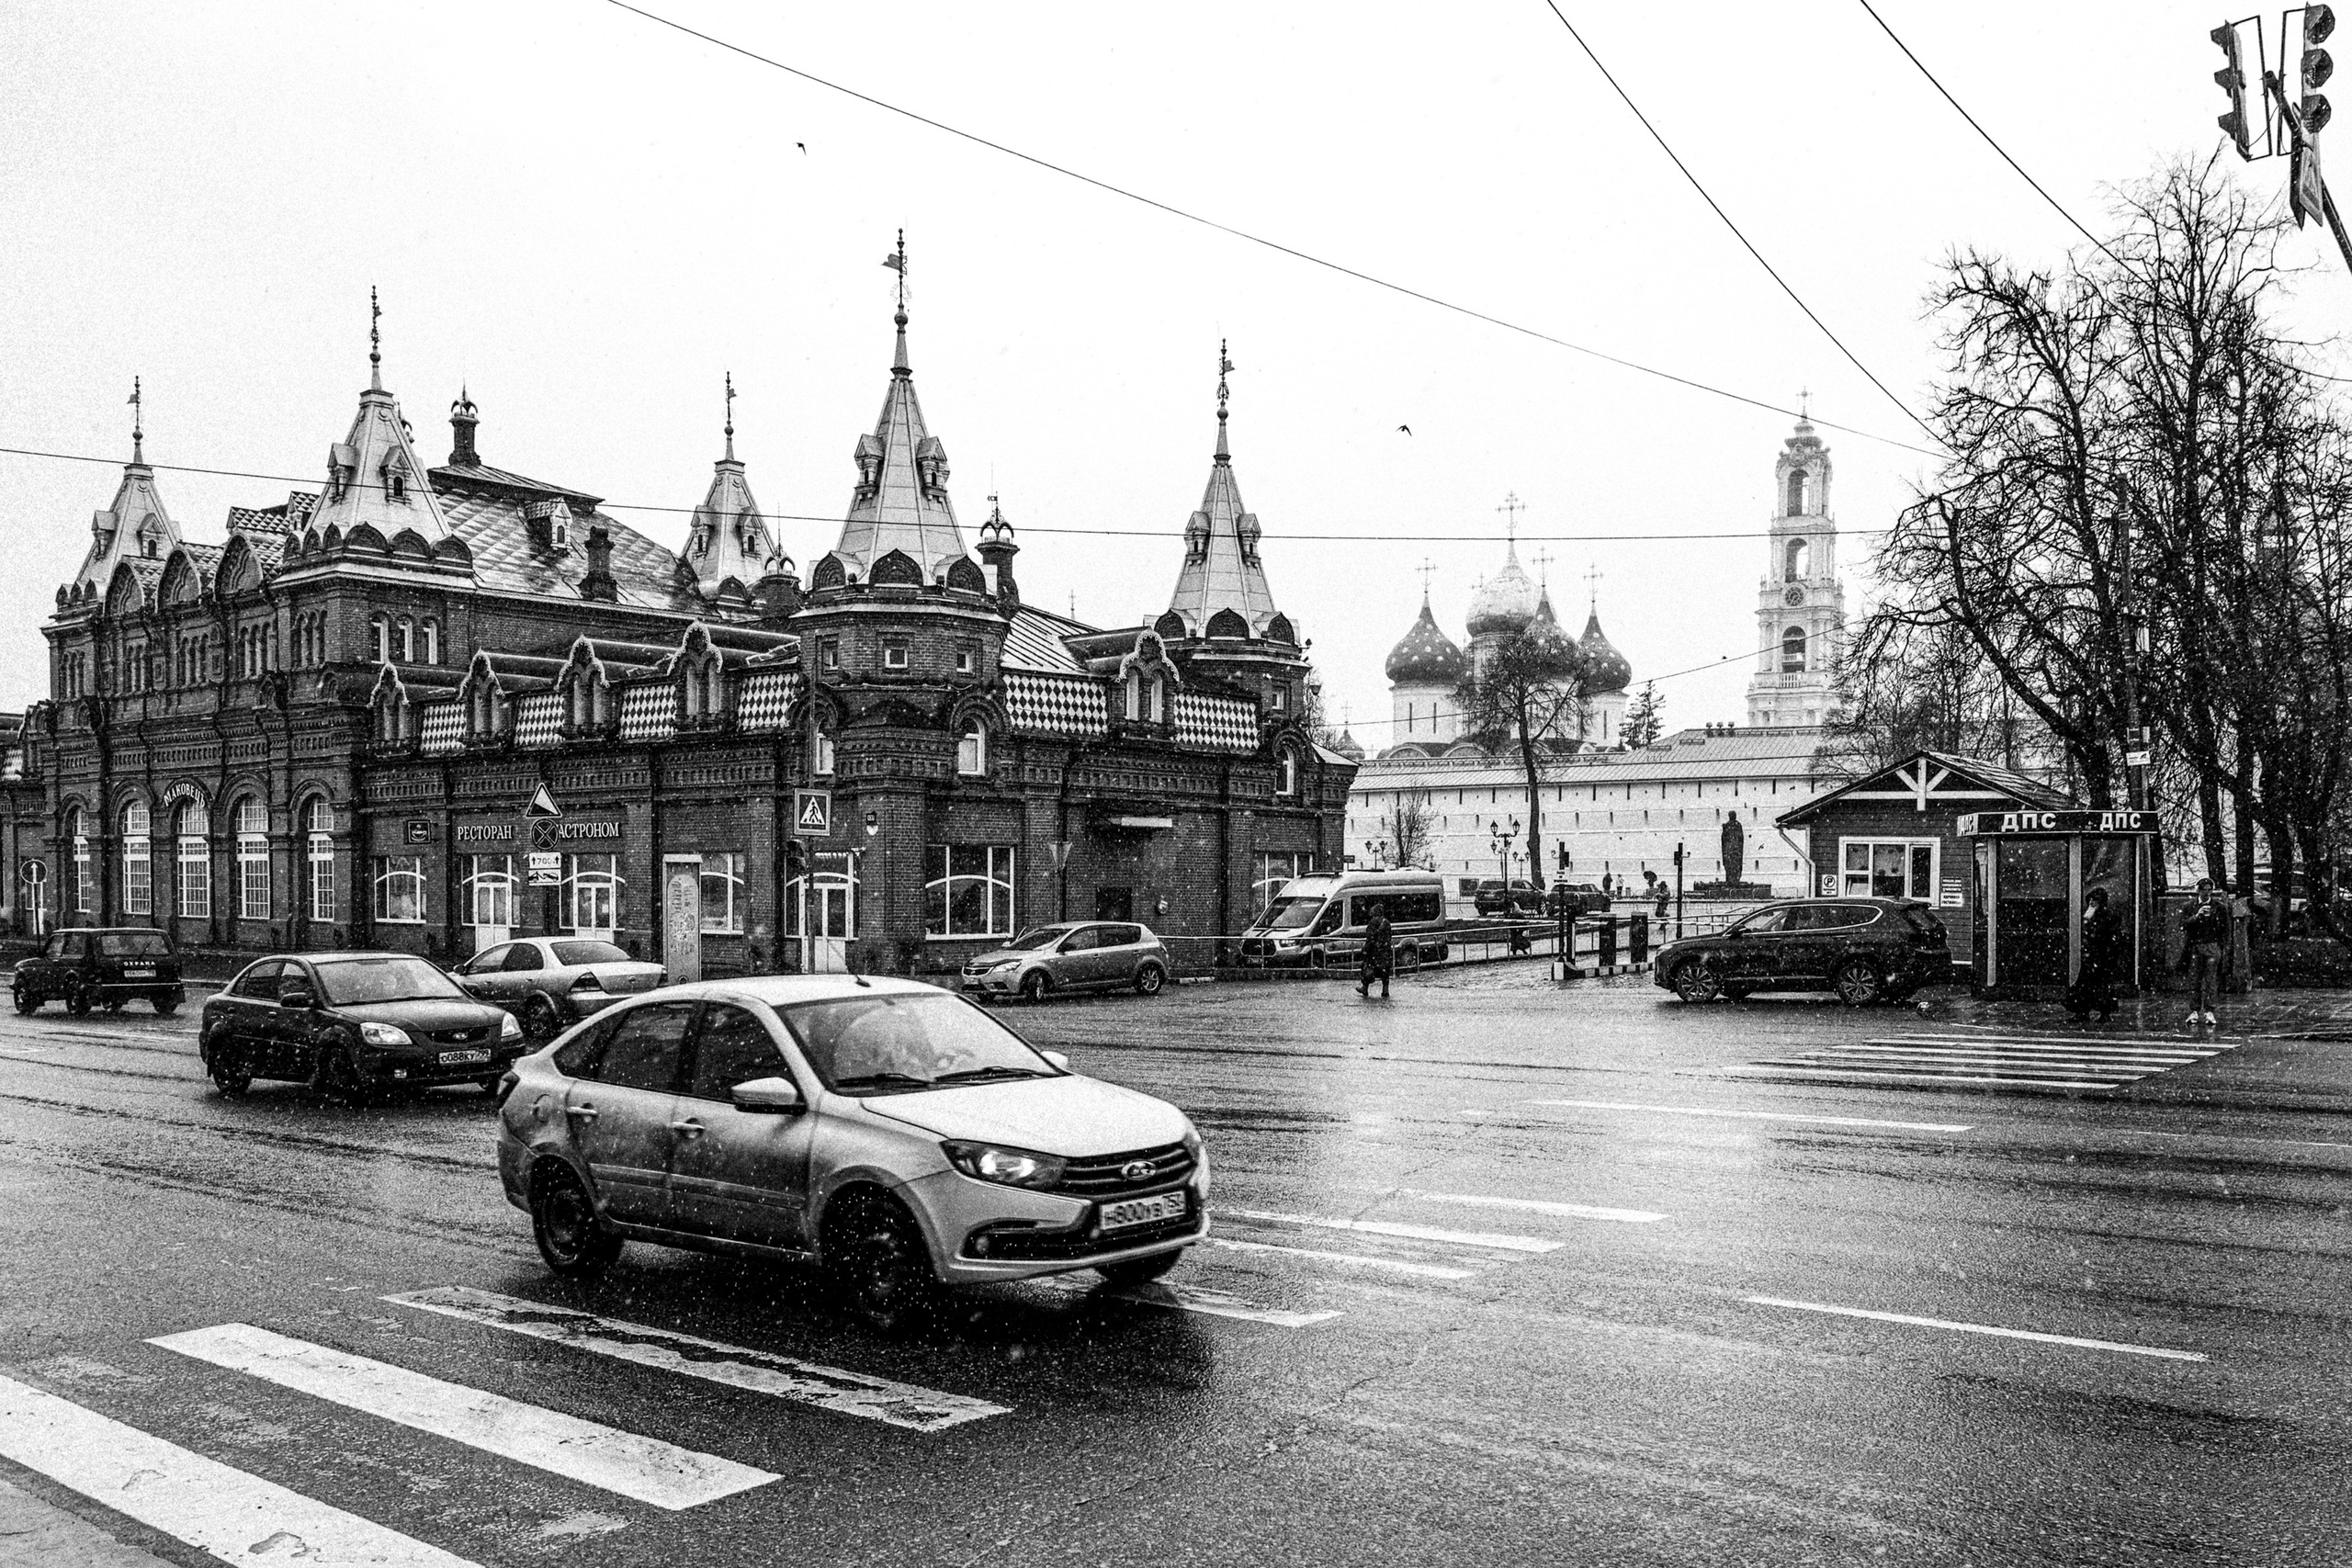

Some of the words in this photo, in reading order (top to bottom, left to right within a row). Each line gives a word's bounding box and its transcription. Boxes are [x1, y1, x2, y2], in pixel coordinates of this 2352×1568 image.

[164, 783, 206, 808] МАКОВЕЦЪ
[556, 822, 620, 839] АСТРОНОМ
[2001, 813, 2056, 832] ДПС
[2099, 812, 2142, 831] ДПС
[457, 824, 513, 840] РЕСТОРАН
